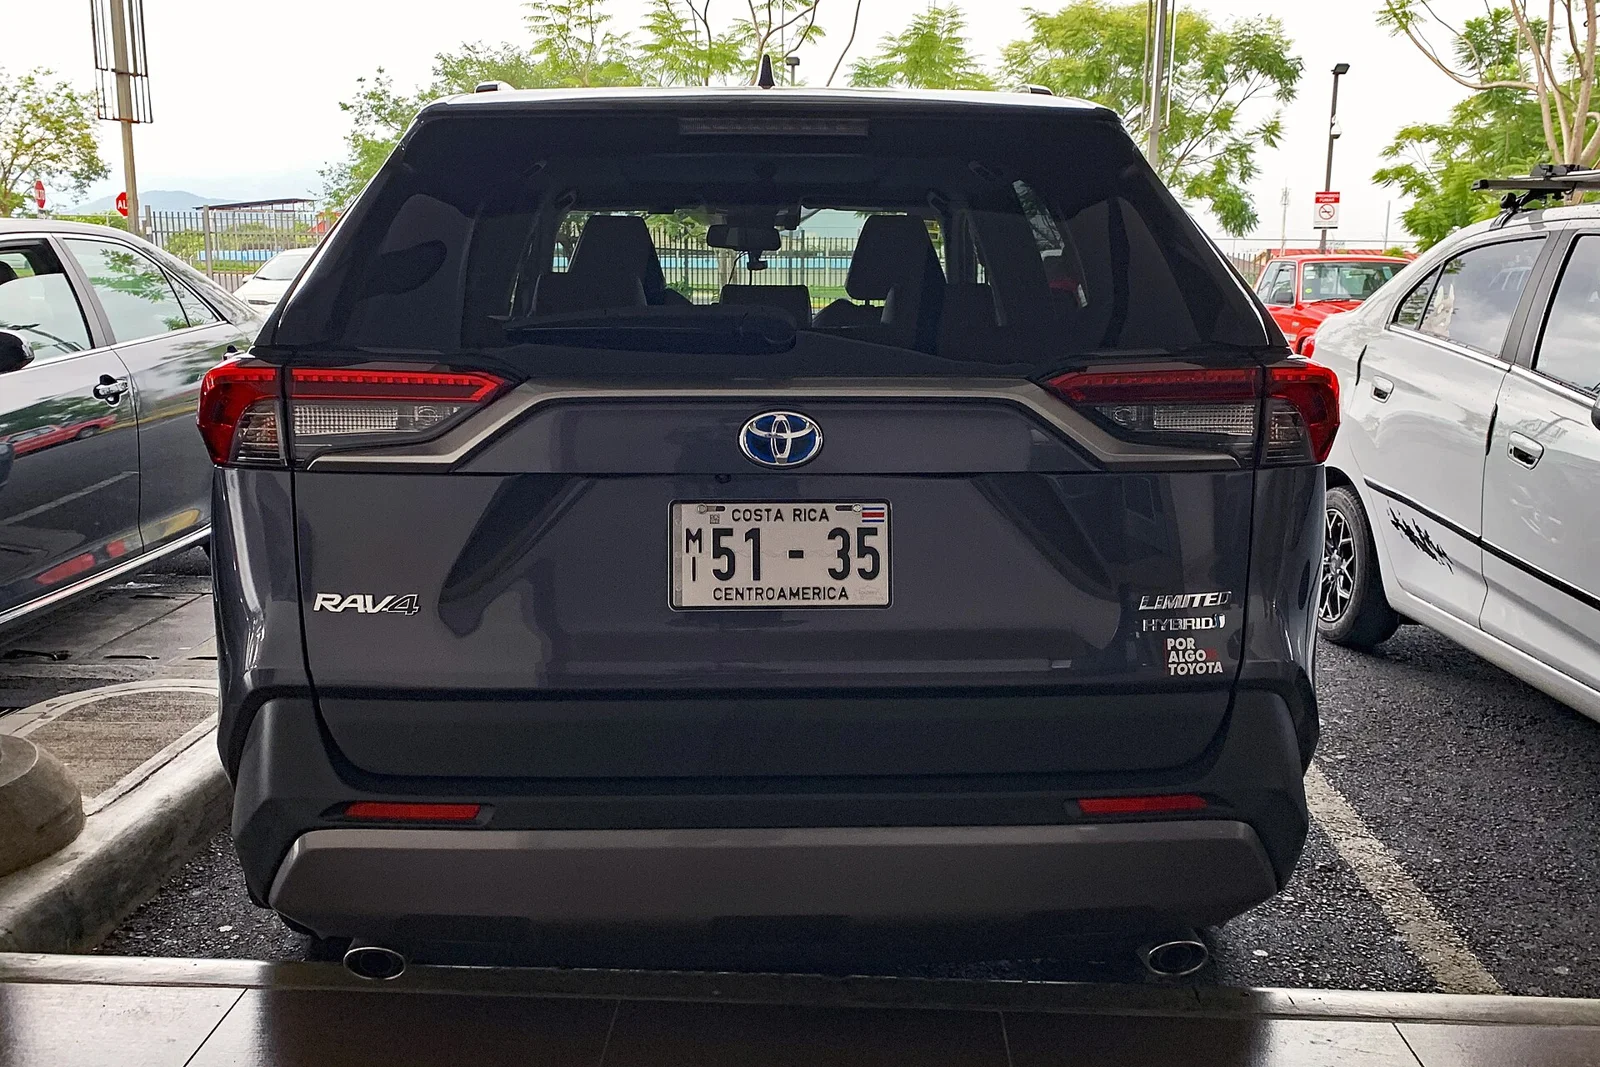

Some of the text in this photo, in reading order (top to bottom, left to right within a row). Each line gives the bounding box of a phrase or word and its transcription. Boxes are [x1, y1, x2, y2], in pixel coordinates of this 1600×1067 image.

[117, 200, 128, 209] AL
[731, 508, 830, 522] COSTA RICA
[712, 527, 761, 581] 51
[827, 527, 880, 581] 35
[713, 586, 849, 600] CENTROAMERICA
[313, 593, 420, 616] RAV4
[1139, 591, 1232, 610] LIMITED
[1142, 616, 1216, 631] HYBRID
[1166, 637, 1195, 650] POR
[1168, 649, 1207, 663] ALGO
[1168, 661, 1223, 676] TOYOTA
